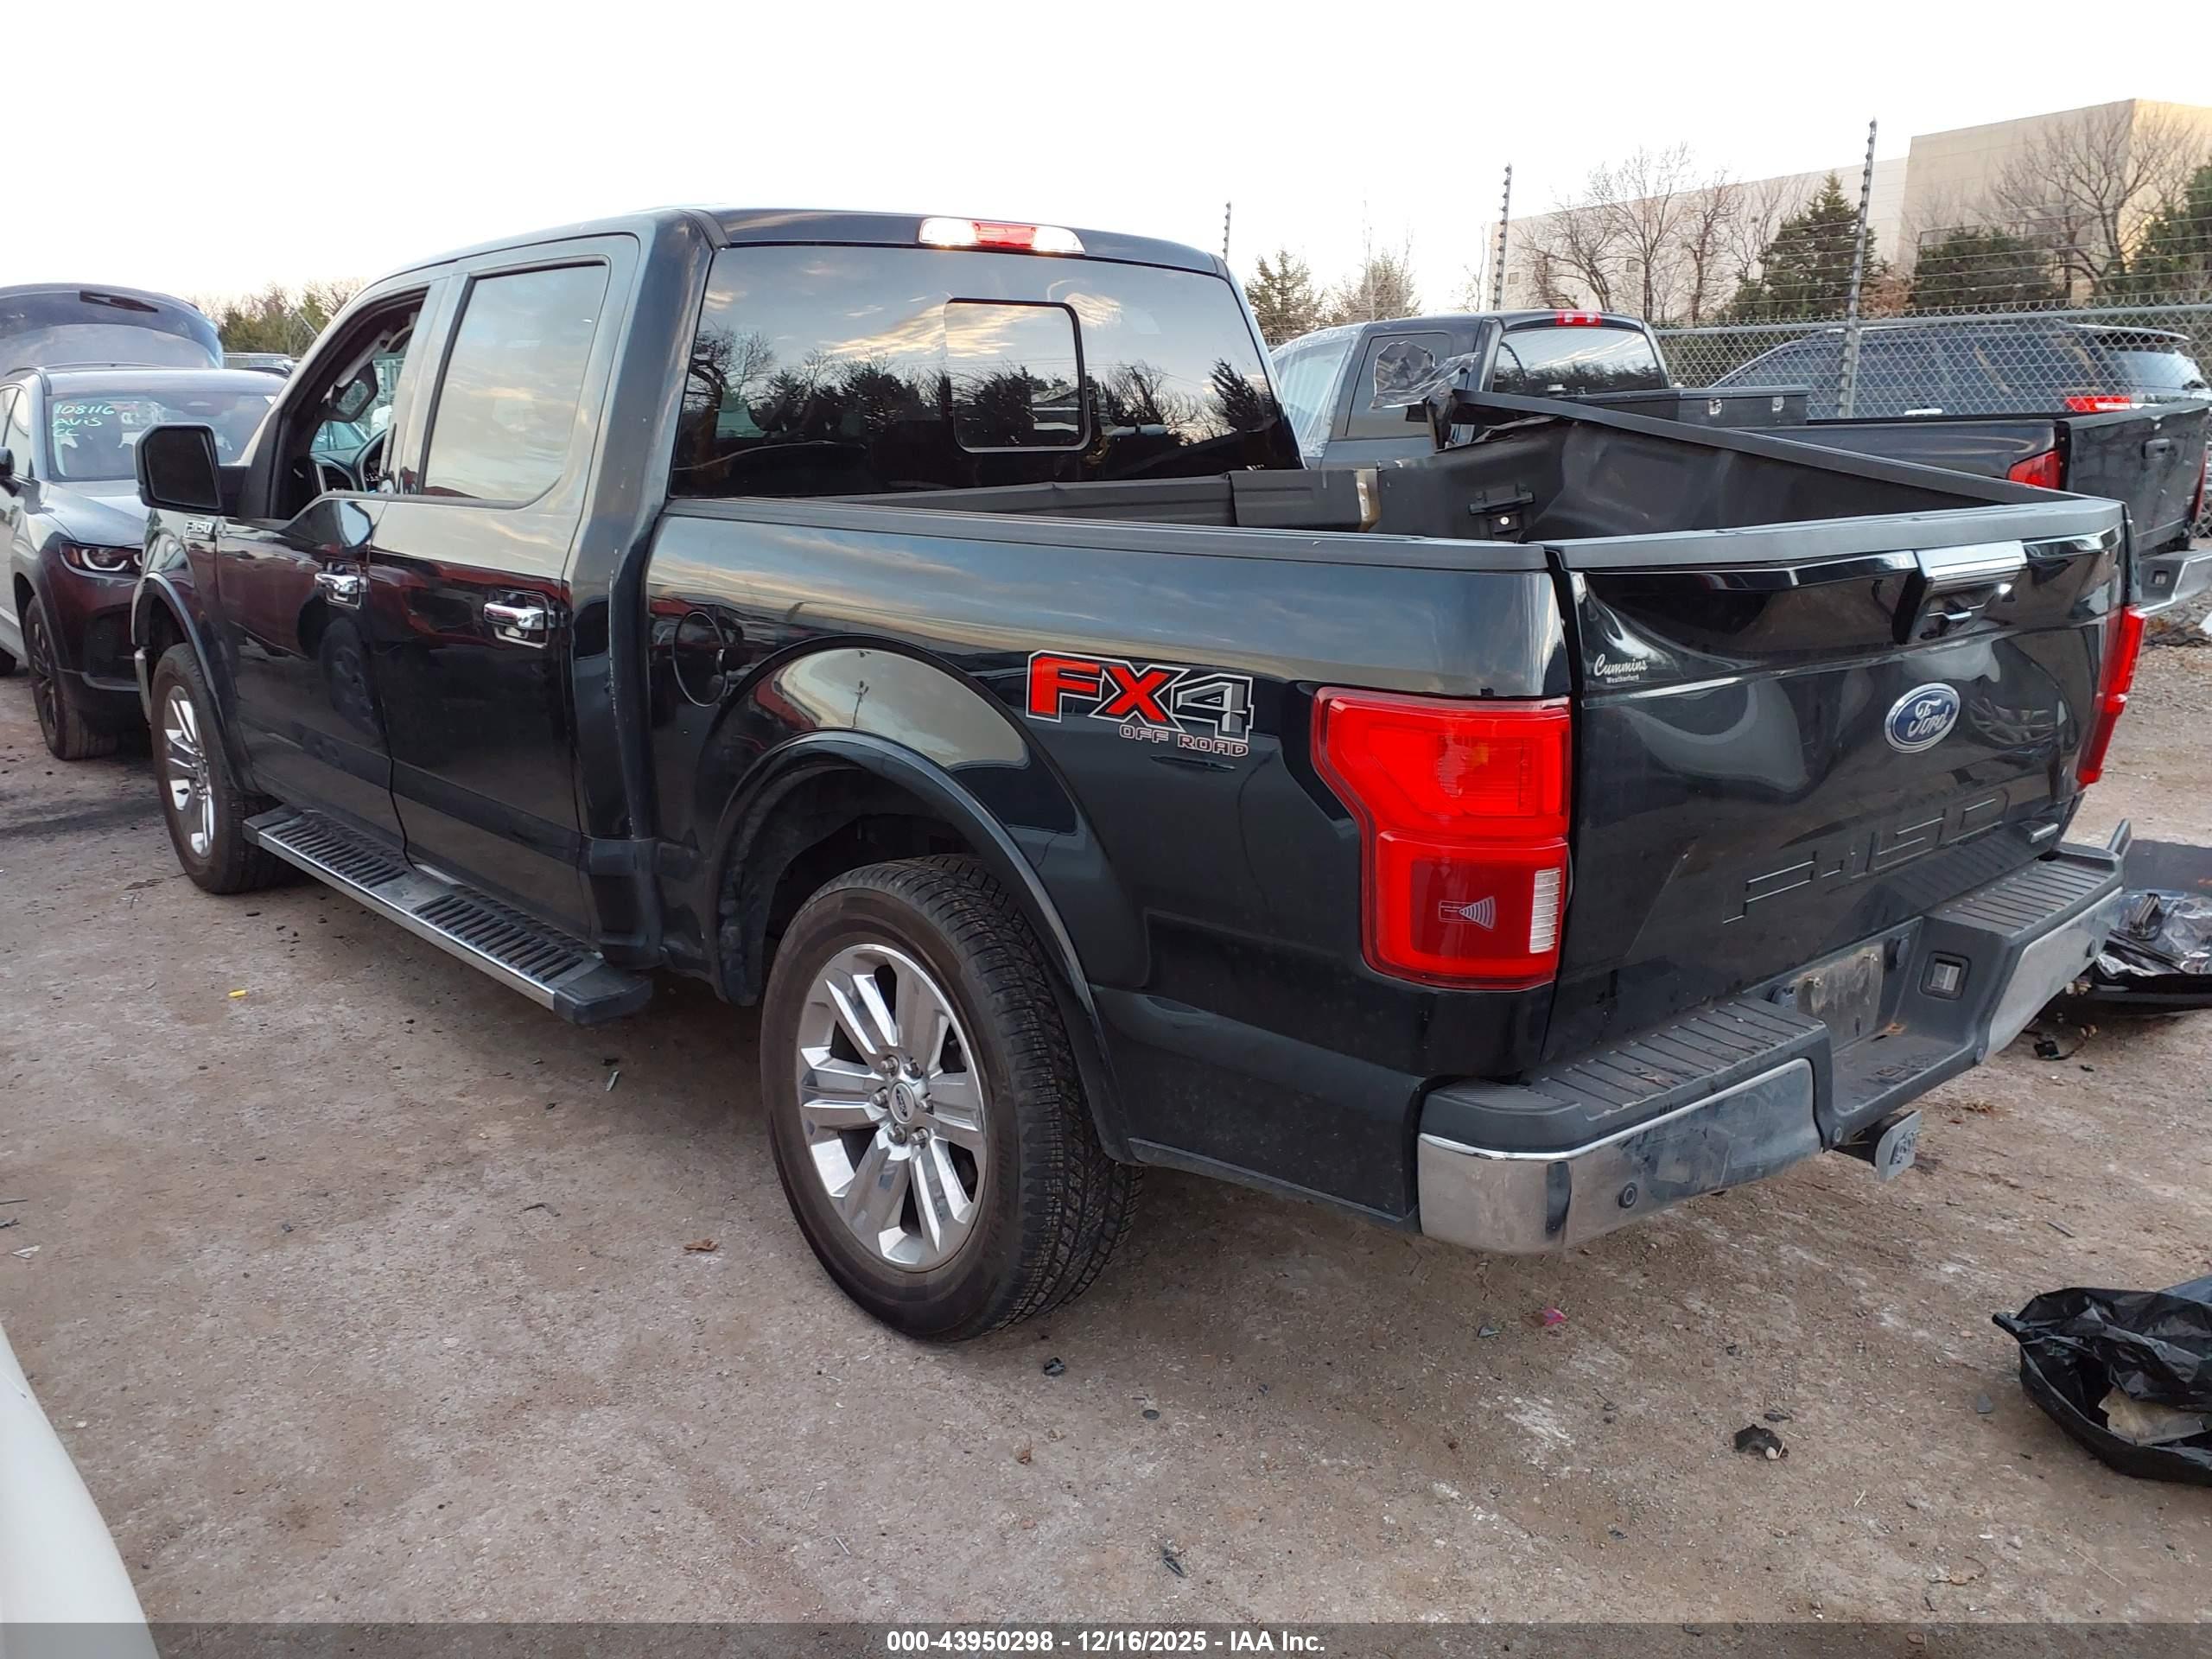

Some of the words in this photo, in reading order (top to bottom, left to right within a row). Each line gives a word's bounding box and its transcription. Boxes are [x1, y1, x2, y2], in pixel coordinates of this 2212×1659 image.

[1593, 653, 1648, 677] Cummins
[1027, 650, 1254, 742] FX4
[1907, 698, 1948, 738] Ford
[1120, 724, 1168, 743] OFF
[1177, 734, 1249, 757] ROAD
